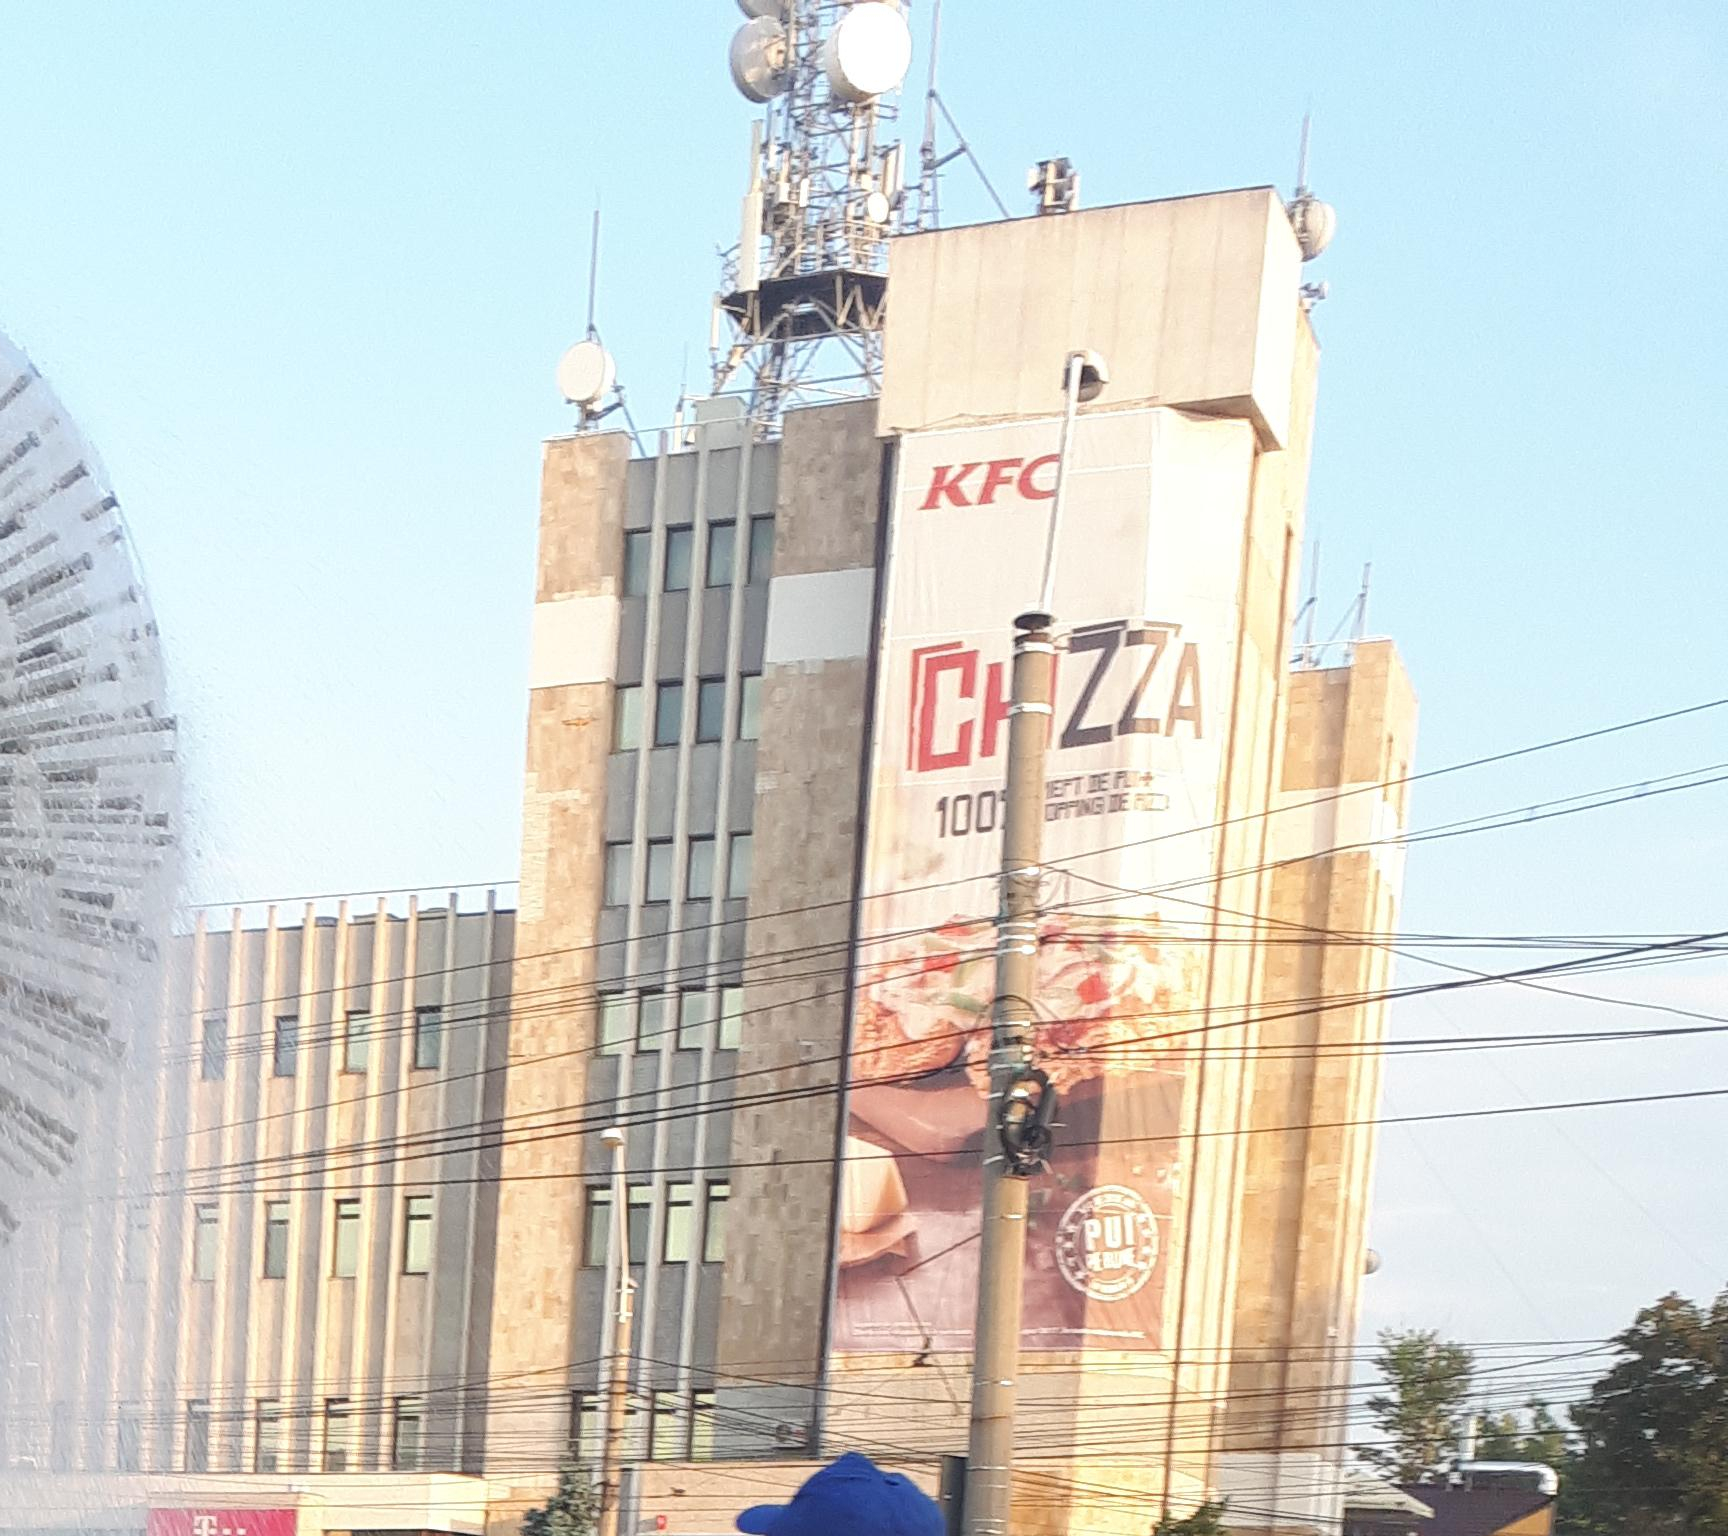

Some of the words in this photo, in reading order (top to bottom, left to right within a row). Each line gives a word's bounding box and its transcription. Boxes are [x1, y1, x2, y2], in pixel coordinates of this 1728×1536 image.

[917, 453, 1061, 510] KFC
[907, 618, 1202, 772] CHZZA
[936, 789, 1007, 838] 100
[1045, 798, 1105, 822] OPPING
[1084, 1214, 1135, 1252] PUI
